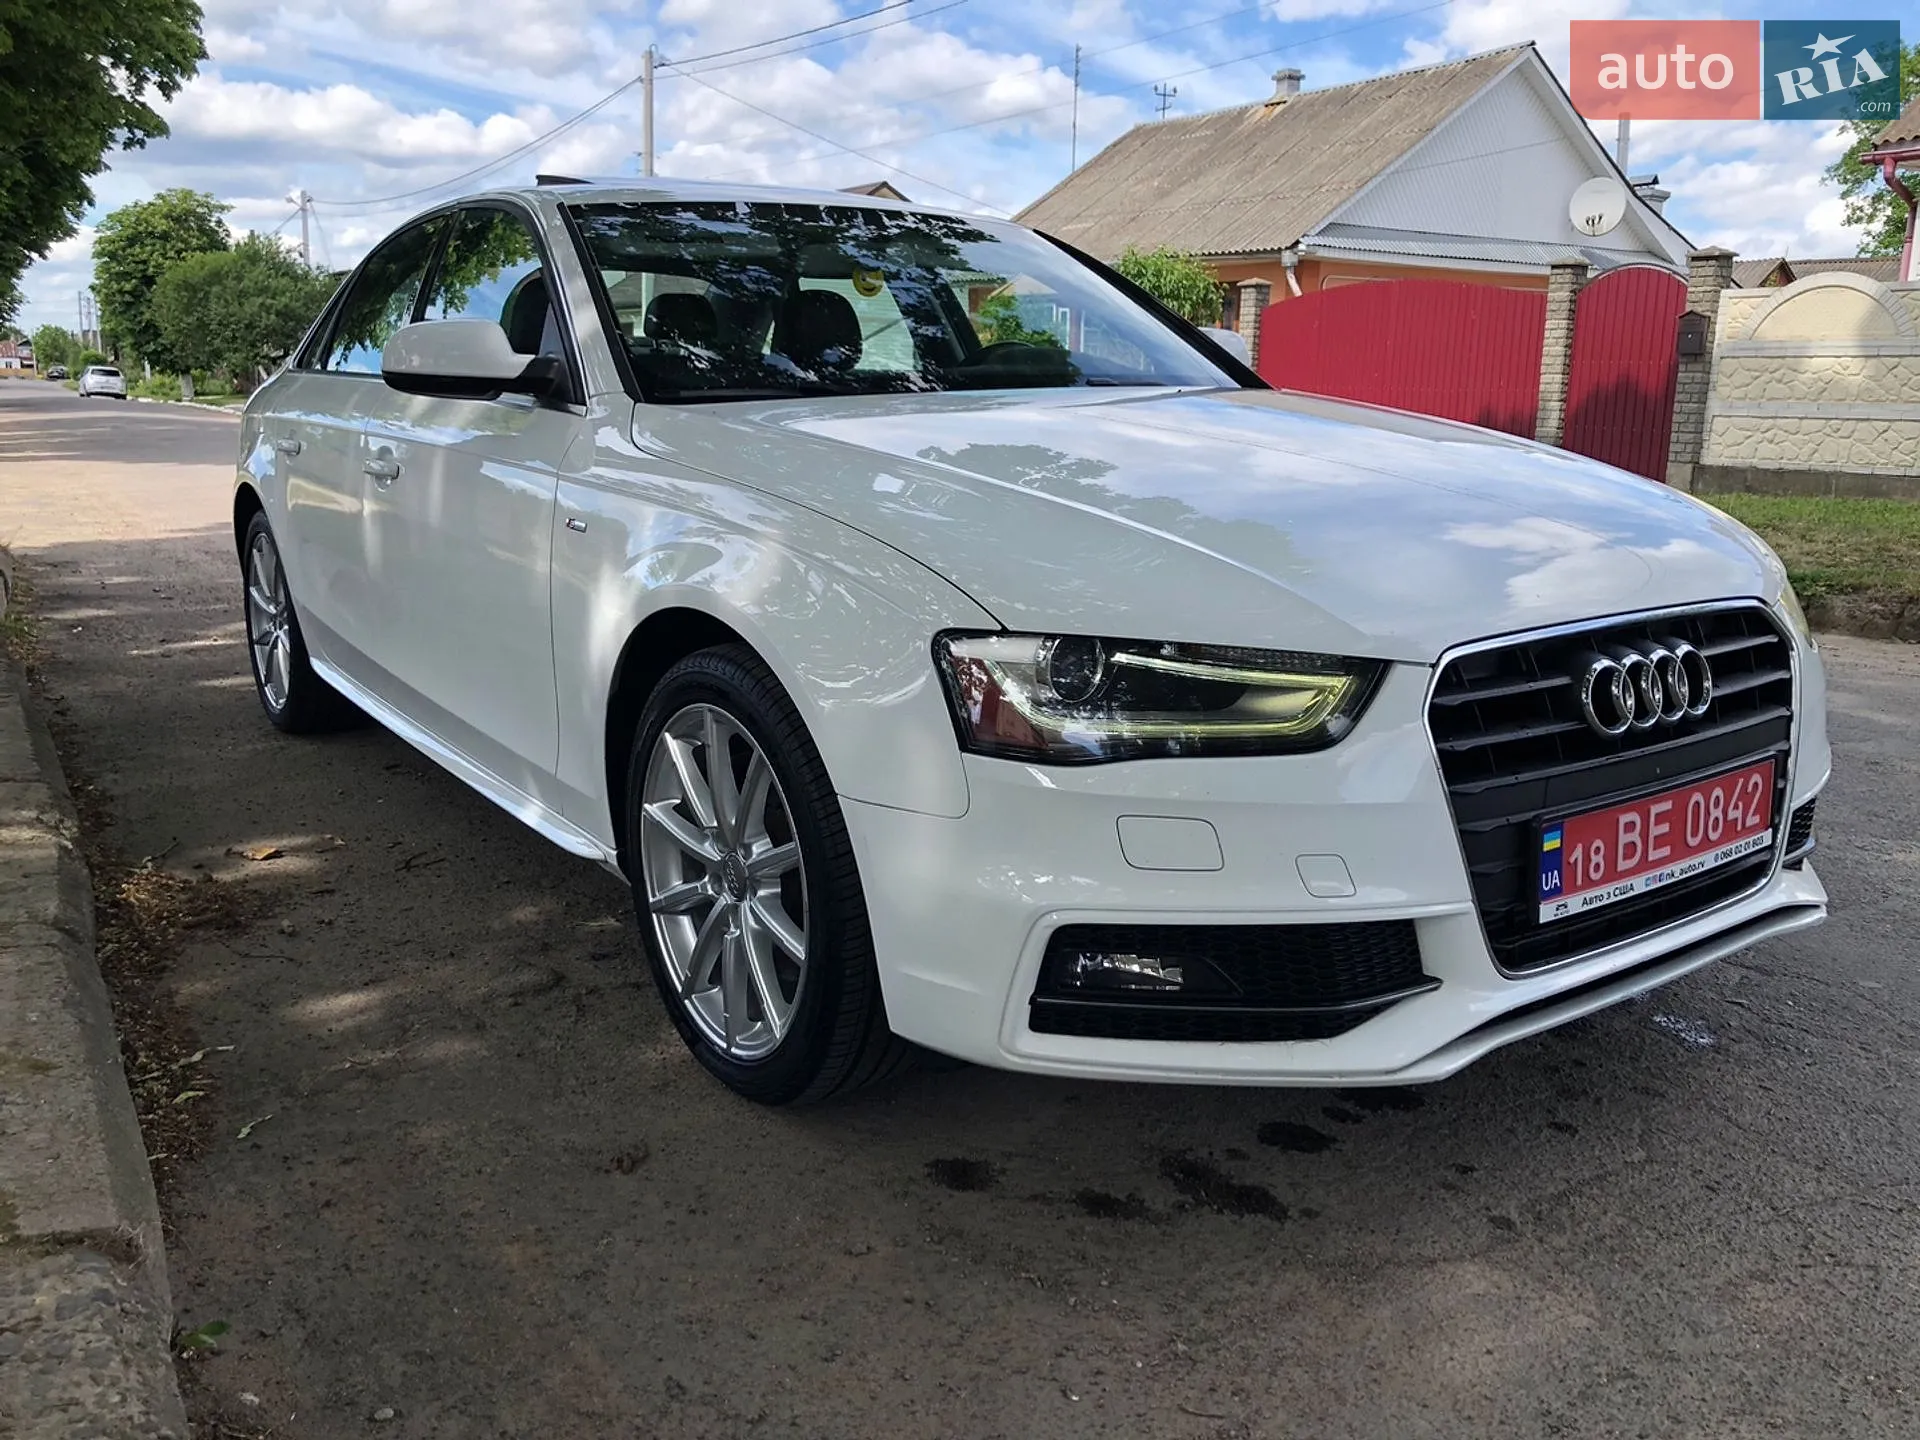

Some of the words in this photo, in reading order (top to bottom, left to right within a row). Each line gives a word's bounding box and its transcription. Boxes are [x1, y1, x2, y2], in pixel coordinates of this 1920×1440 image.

[1568, 838, 1605, 886] 18
[1616, 800, 1673, 873] BE
[1686, 773, 1762, 847] 0842
[1542, 871, 1561, 891] UA
[1613, 883, 1635, 898] США
